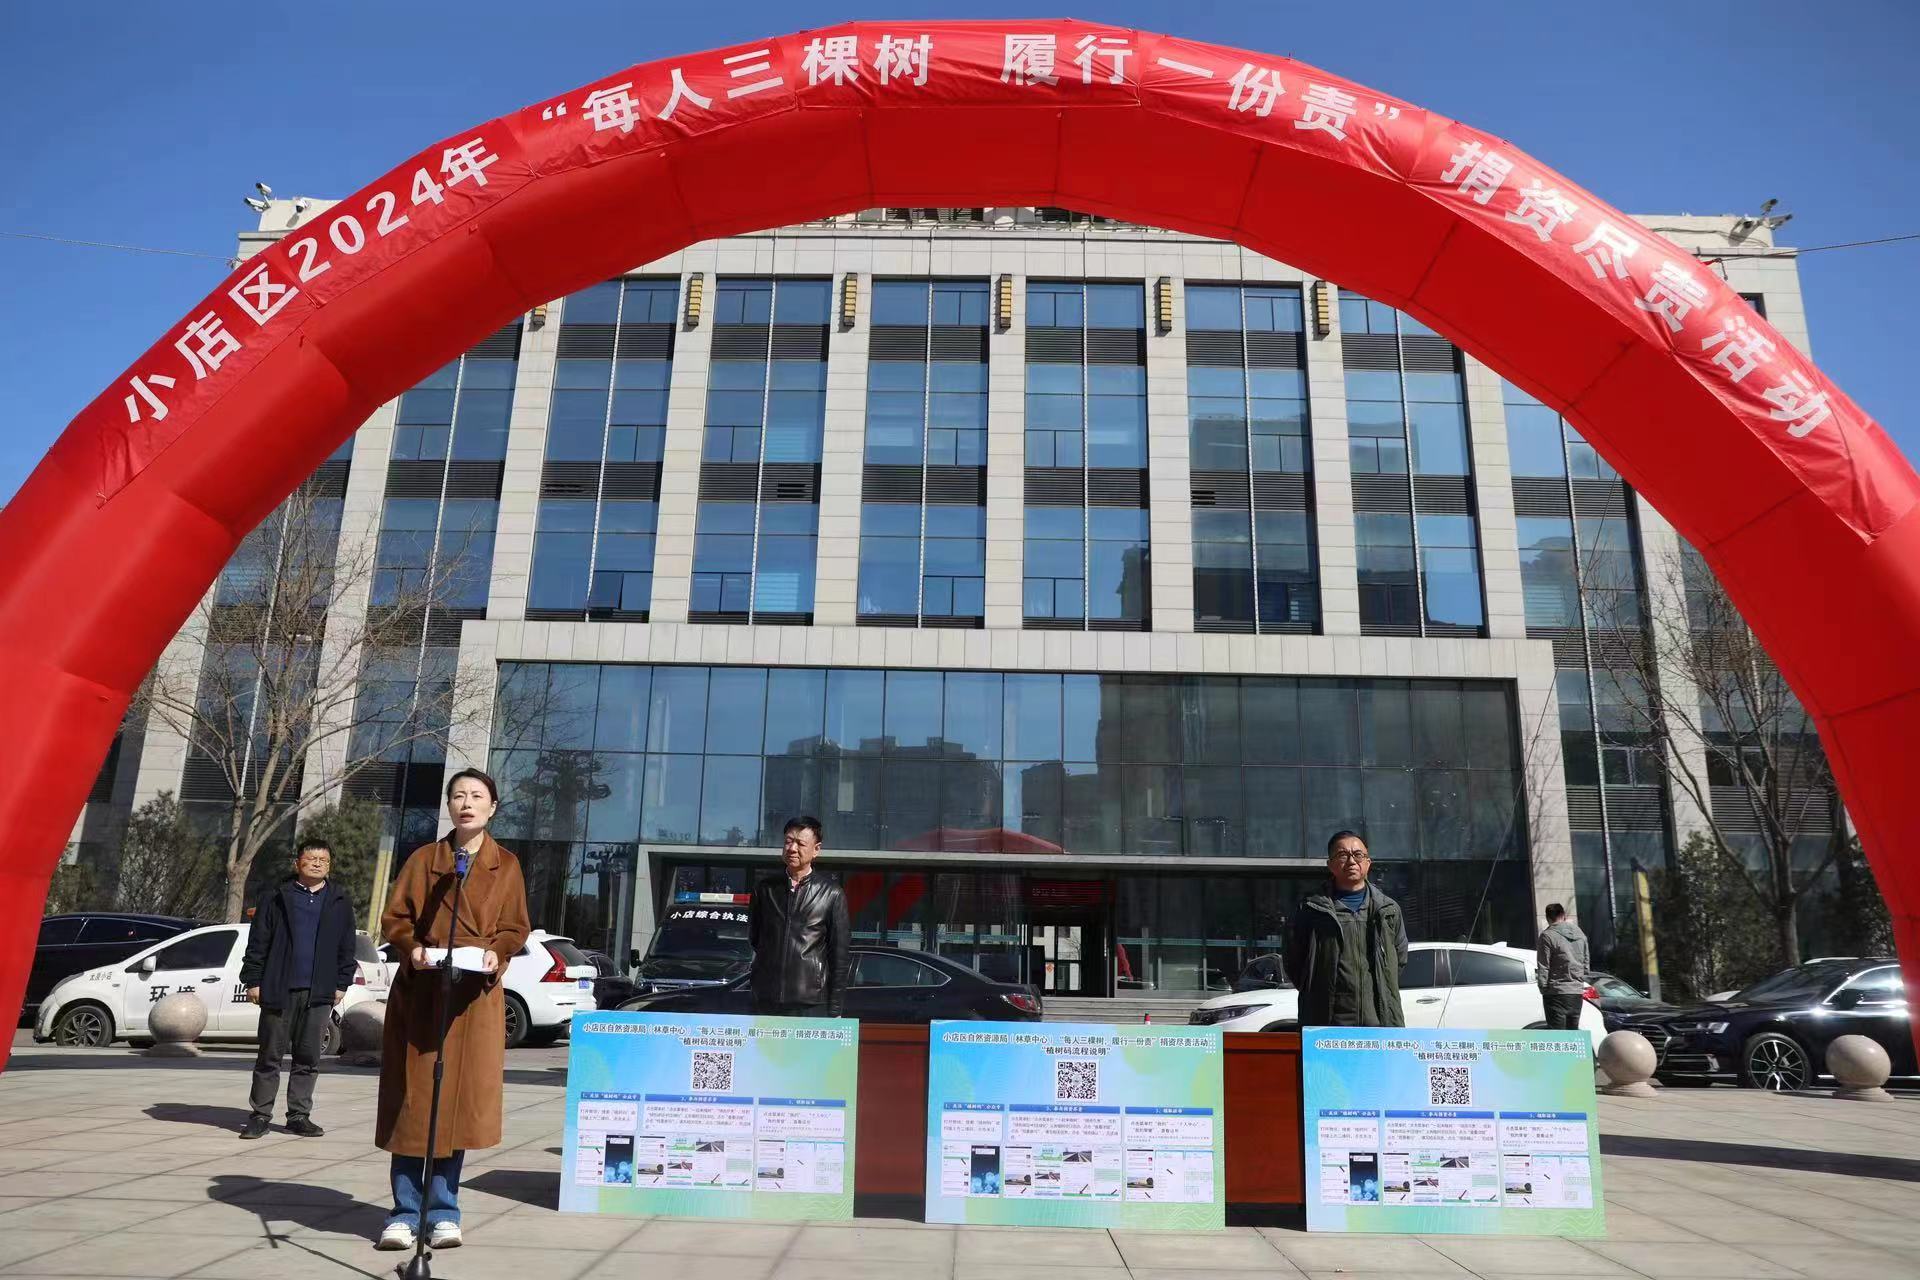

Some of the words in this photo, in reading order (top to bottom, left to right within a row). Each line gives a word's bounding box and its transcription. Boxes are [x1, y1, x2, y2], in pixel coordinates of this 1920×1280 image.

[124, 138, 499, 424] 小店区2024年
[1440, 141, 1833, 438] 捐资尽责活动
[670, 910, 749, 922] 小店综合执法
